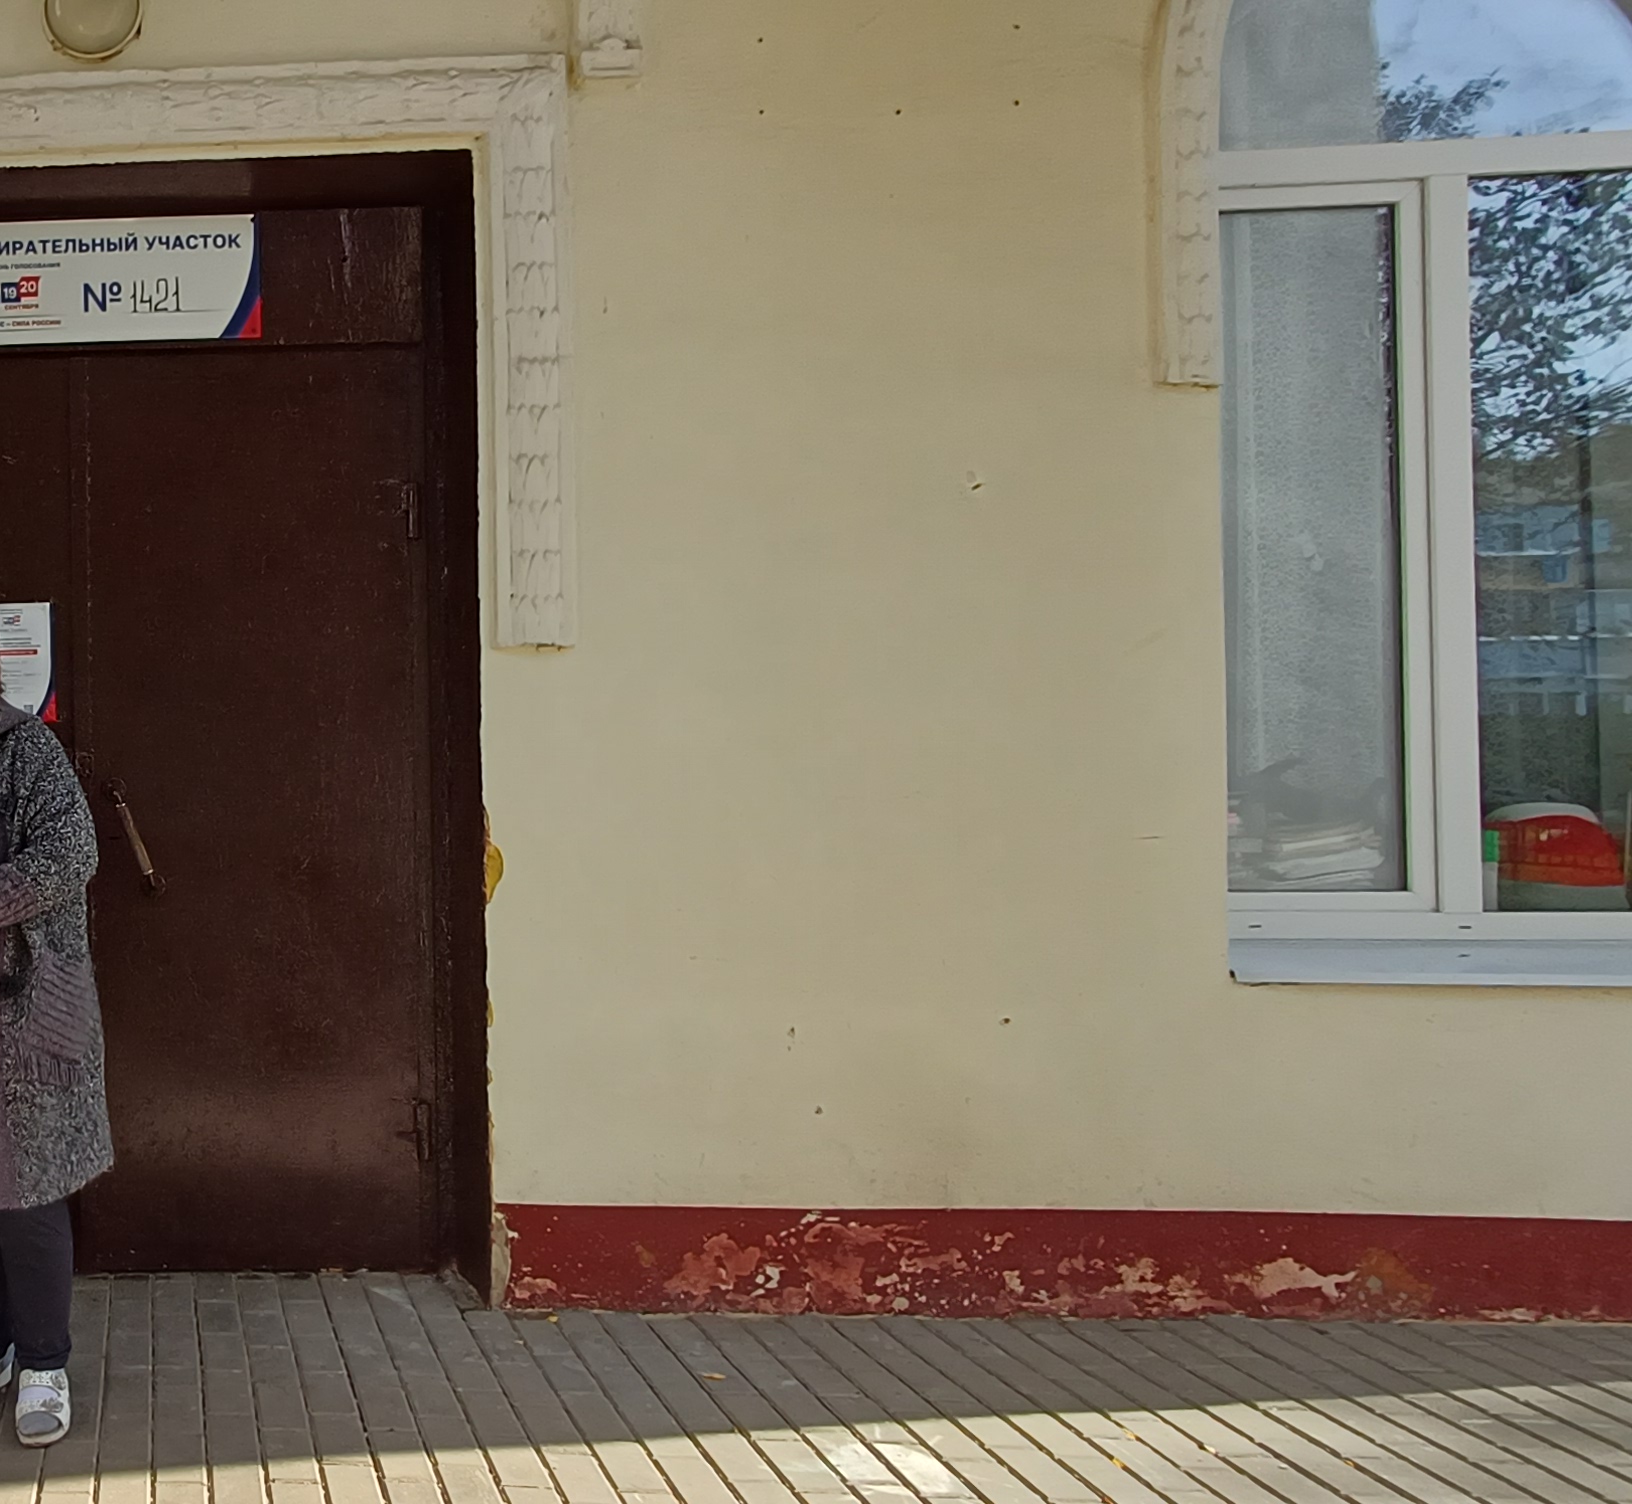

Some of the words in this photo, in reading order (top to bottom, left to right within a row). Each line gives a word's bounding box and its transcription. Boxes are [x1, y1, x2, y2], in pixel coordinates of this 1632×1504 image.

[145, 233, 242, 251] УЧАСТОК
[2, 286, 17, 299] 19
[19, 281, 37, 293] 20
[82, 281, 122, 313] №
[129, 276, 183, 314] 1421
